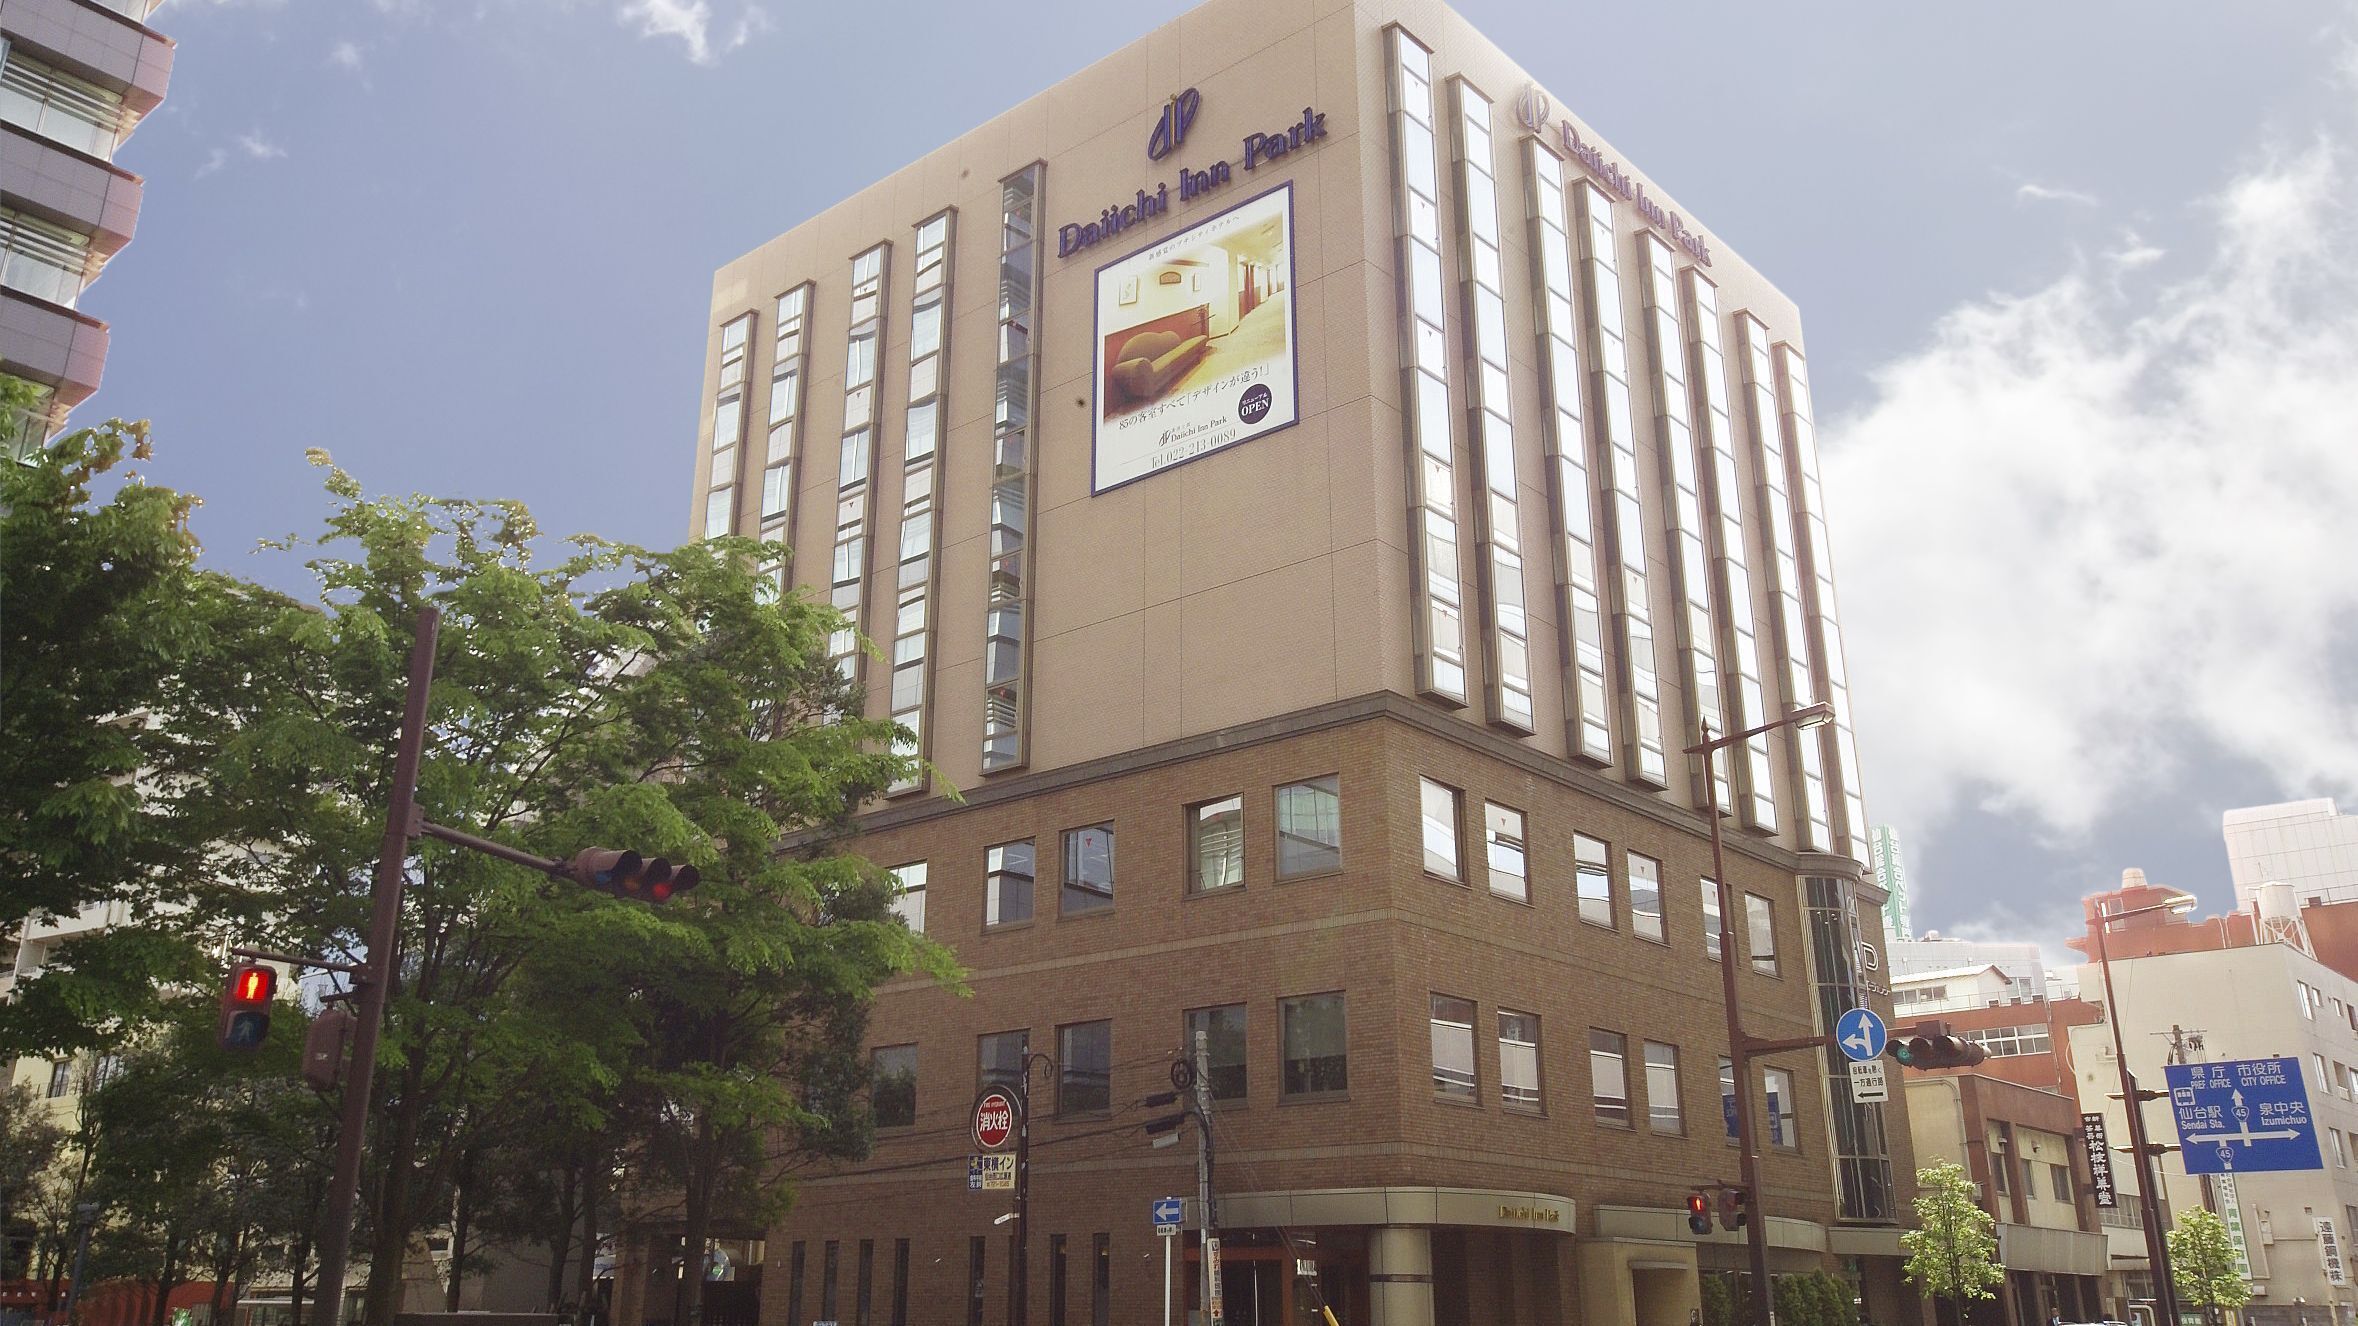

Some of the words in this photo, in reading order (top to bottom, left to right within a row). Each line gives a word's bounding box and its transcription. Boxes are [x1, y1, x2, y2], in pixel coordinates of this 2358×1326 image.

[1057, 182, 1168, 258] Daiichi
[1179, 160, 1231, 201] Inn
[1242, 106, 1328, 171] Park
[1561, 119, 1633, 201] Daiichi
[1635, 182, 1666, 230] Inn
[1668, 210, 1713, 267] Park
[1241, 398, 1270, 417] OPEN
[1171, 428, 1196, 442] Daiichi
[1197, 424, 1209, 432] Inn
[1210, 415, 1227, 428] Park
[2190, 1065, 2225, 1080] 県庁
[2236, 1061, 2282, 1077] 市役所
[2209, 1078, 2232, 1089] OFFICE
[2241, 1076, 2258, 1087] CITY
[2260, 1074, 2287, 1086] OFFICE
[2178, 1106, 2223, 1120] 仙台駅
[2236, 1108, 2247, 1117] 45
[2259, 1101, 2306, 1116] 泉中央
[980, 1110, 1009, 1132] 消火栓
[2181, 1120, 2208, 1130] Sendai
[2261, 1115, 2308, 1127] Izumichuo
[2220, 1149, 2231, 1158] 45
[983, 1156, 1015, 1172] 東横イン
